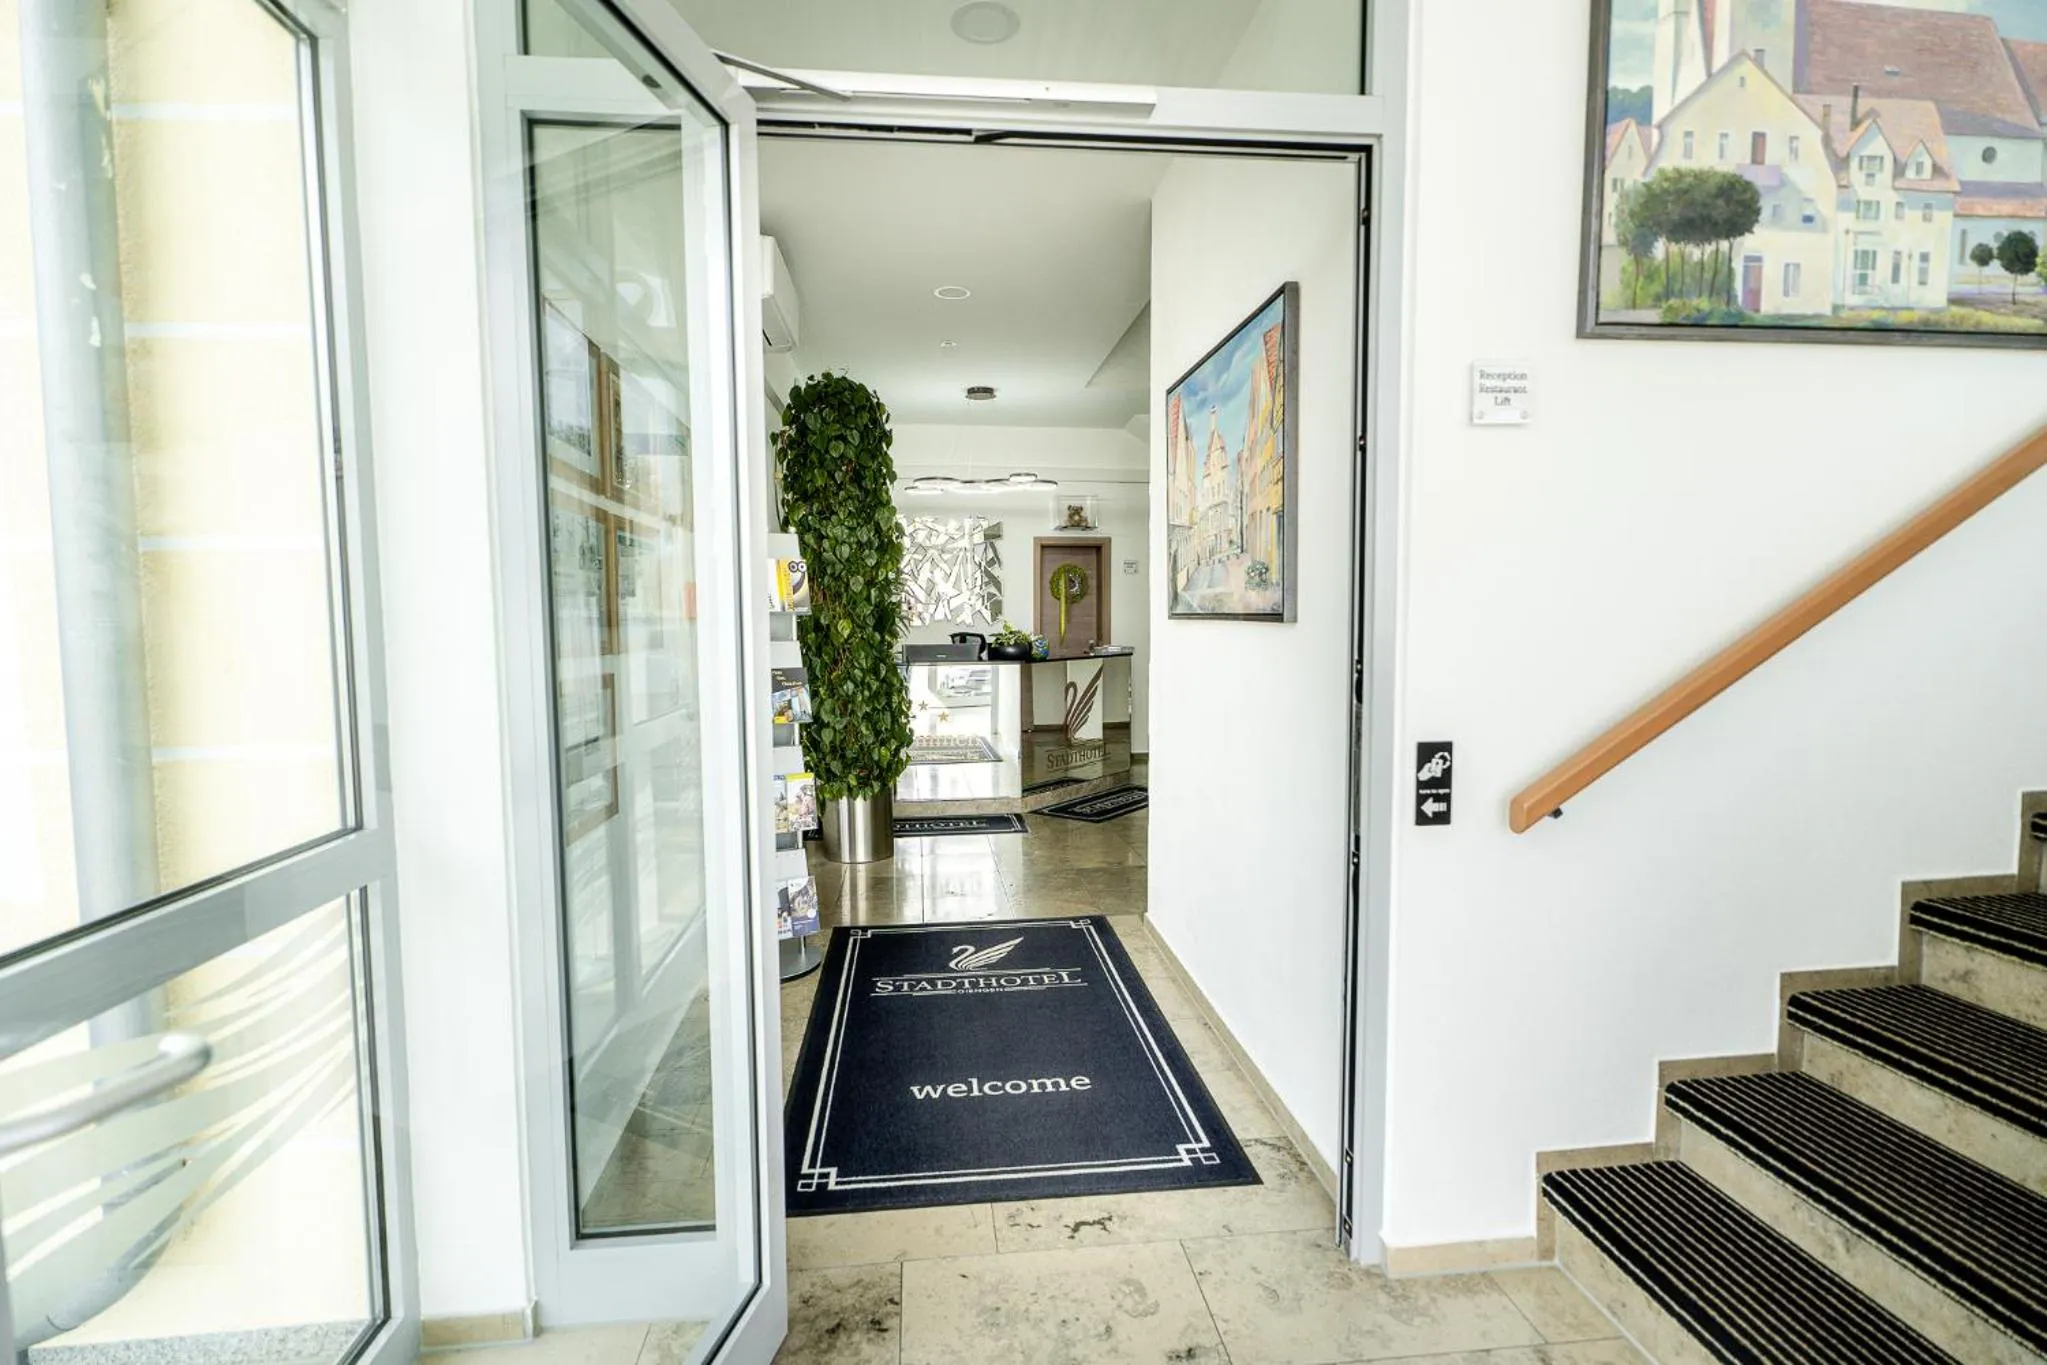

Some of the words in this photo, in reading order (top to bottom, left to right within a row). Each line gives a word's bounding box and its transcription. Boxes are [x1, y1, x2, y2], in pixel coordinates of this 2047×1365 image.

[1480, 369, 1528, 382] Reception
[875, 971, 1082, 993] STADTHOTEL
[910, 1075, 1092, 1100] welcome
